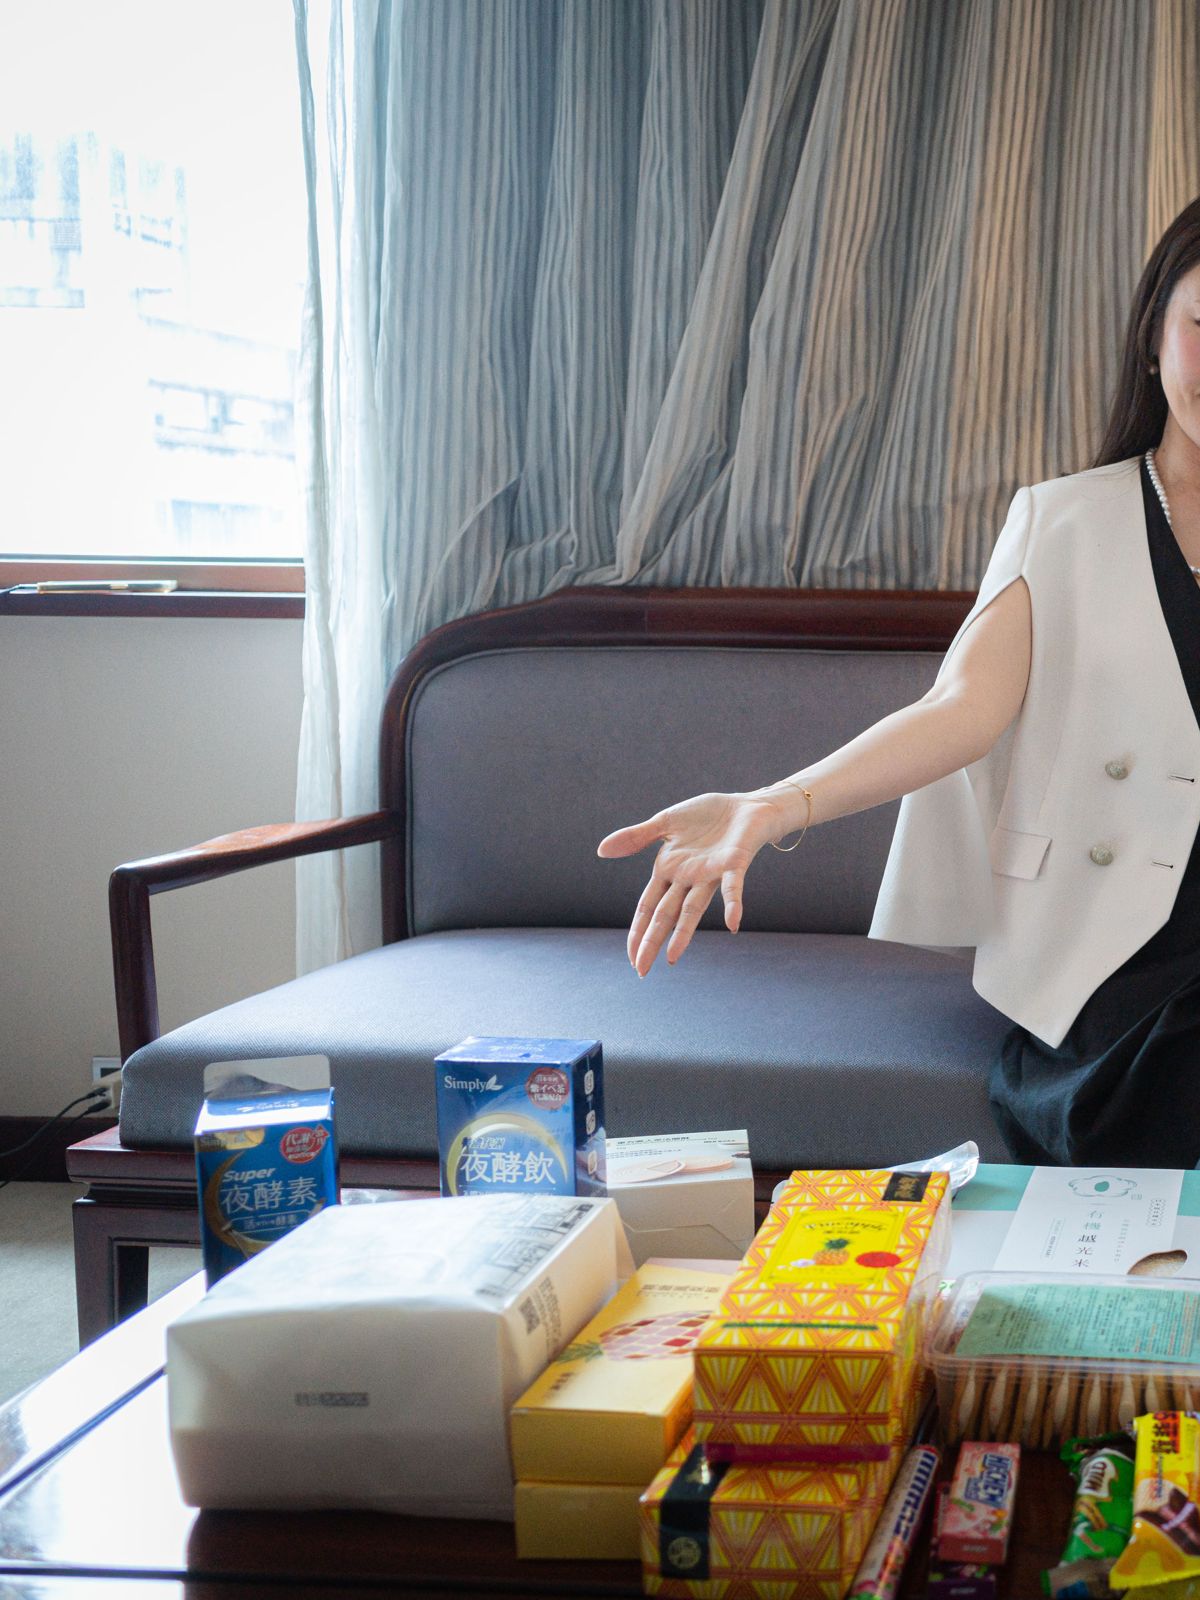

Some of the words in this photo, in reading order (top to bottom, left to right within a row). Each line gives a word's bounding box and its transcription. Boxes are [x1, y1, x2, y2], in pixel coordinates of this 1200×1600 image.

[444, 1075, 487, 1093] Simply
[222, 1167, 277, 1184] Super
[460, 1150, 557, 1185] 夜酵飲
[219, 1176, 319, 1215] 夜酵素
